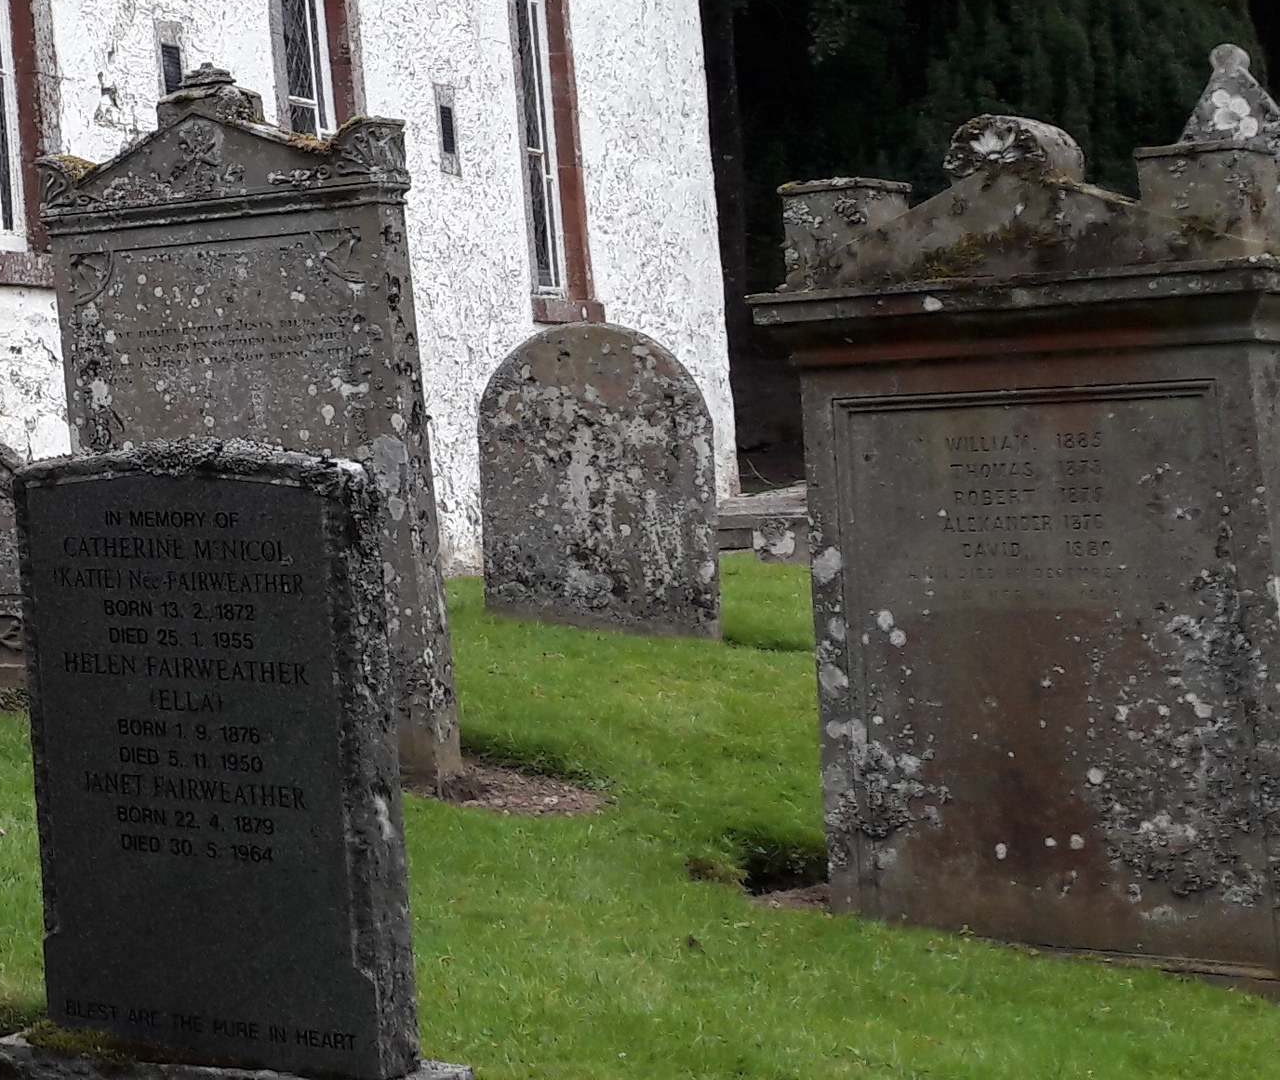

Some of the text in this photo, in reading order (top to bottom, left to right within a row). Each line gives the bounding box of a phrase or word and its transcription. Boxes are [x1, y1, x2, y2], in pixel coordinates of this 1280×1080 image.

[105, 510, 238, 529] IN MEMORY OF
[63, 536, 184, 560] CATHERINE
[103, 599, 153, 618] BORN
[160, 603, 184, 619] 13.
[216, 604, 255, 622] 1872
[108, 627, 254, 650] DIED 25. 1. 1955
[63, 651, 310, 686] HELEN FAIRWEATHER
[150, 688, 224, 713] (ELLA)
[117, 718, 260, 745] BORN 1. 9. 1876
[119, 746, 159, 766] DIED
[193, 752, 212, 770] 11.
[219, 754, 263, 773] 1950
[85, 771, 307, 811] JANET FAIRWEATHER
[117, 806, 275, 836] BORN 22. 4. 1879
[120, 833, 160, 854] DIED
[169, 838, 198, 858] 30.
[231, 843, 275, 864] 1964
[65, 999, 357, 1052] BLEST ARE THE PURE IN HEART
